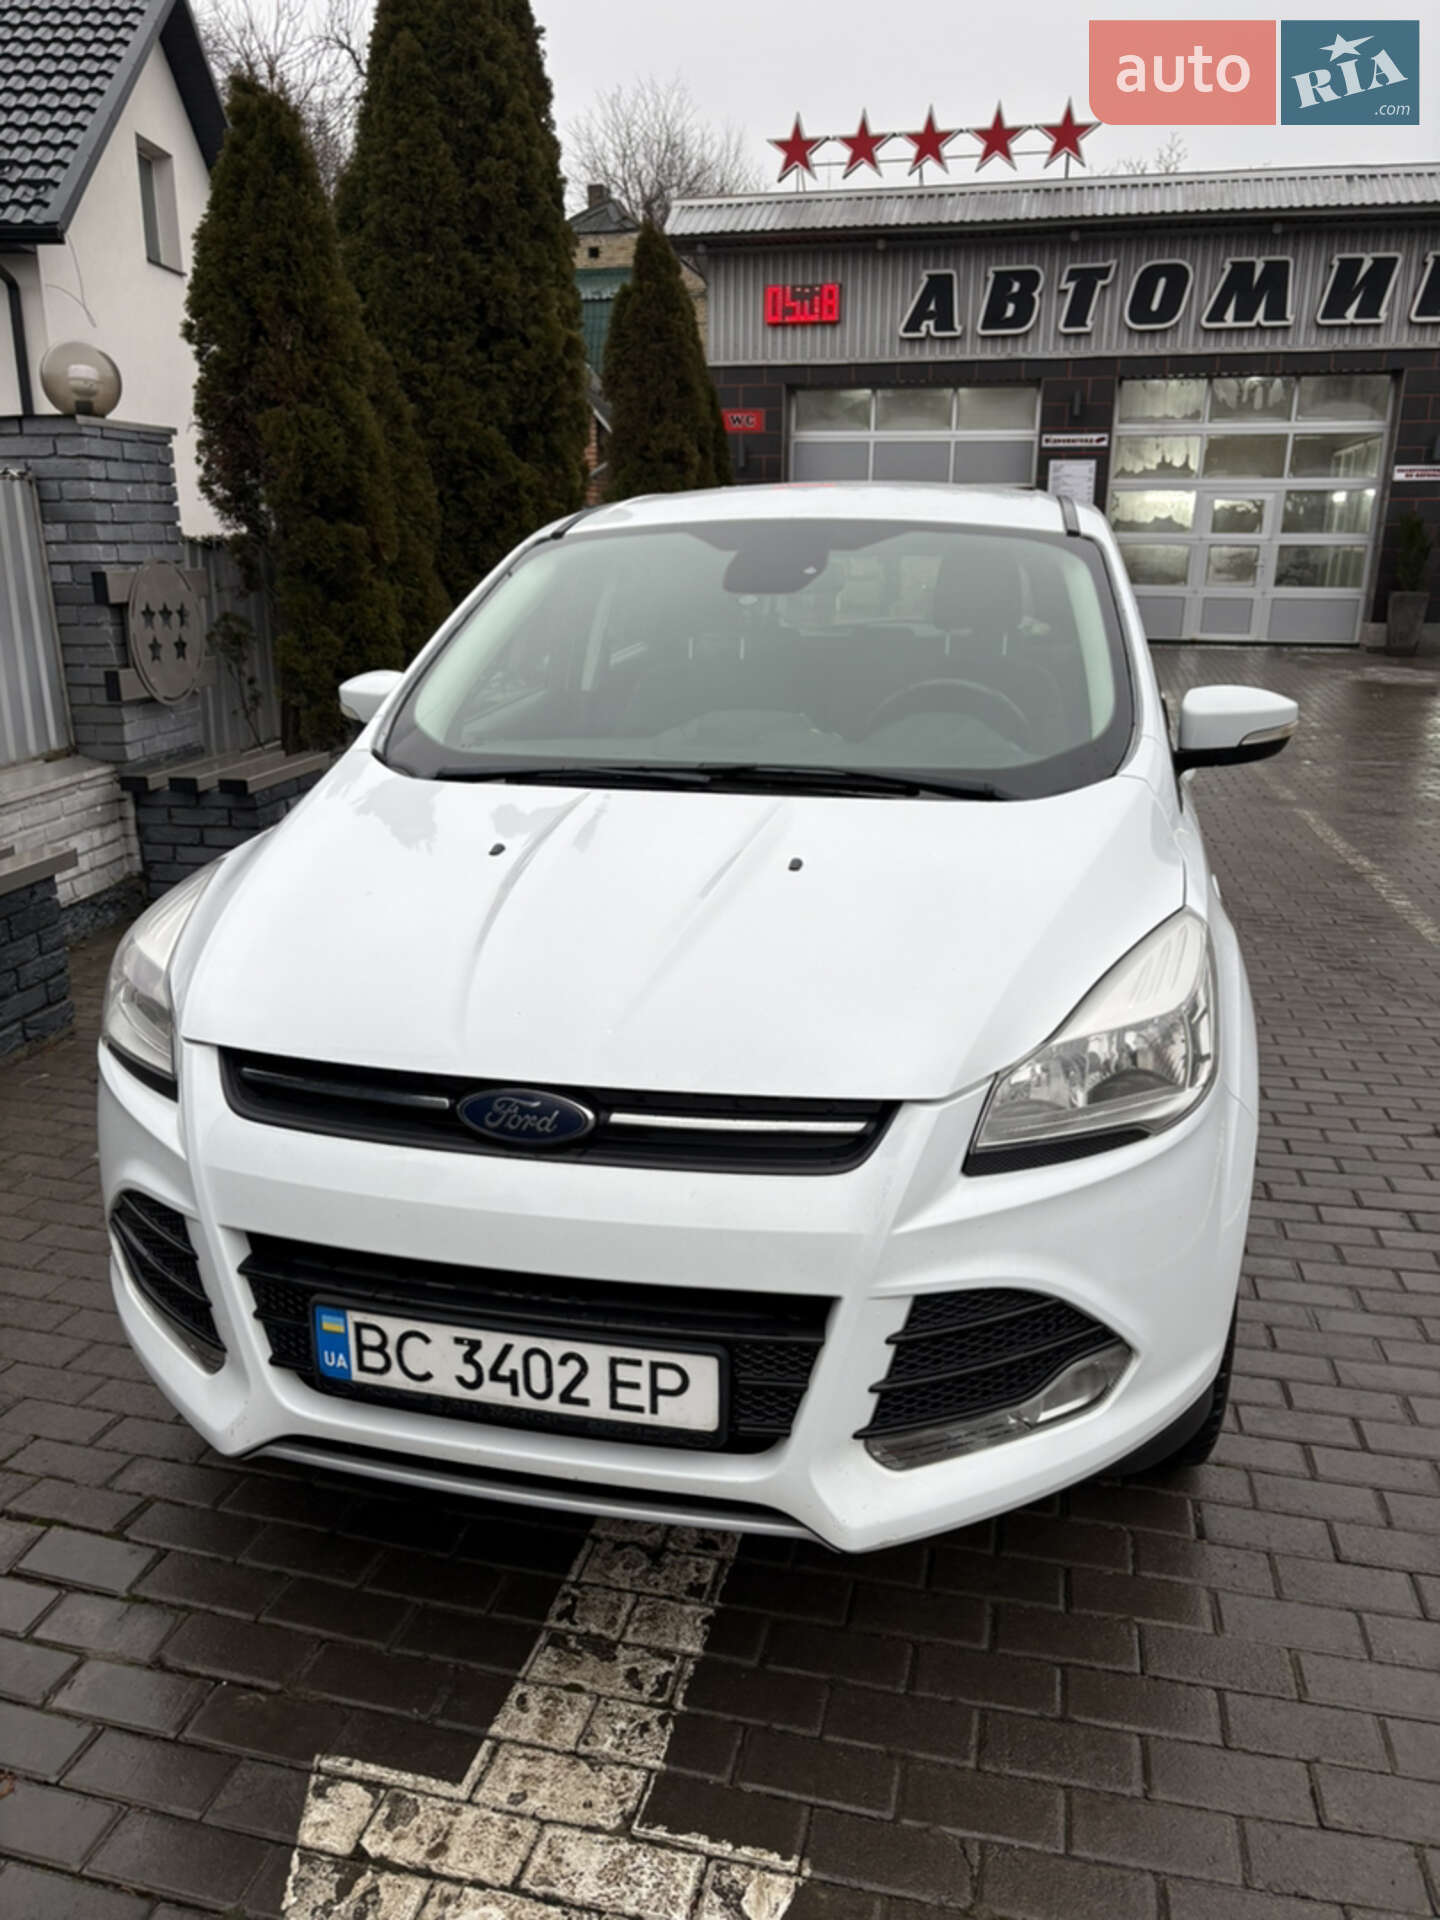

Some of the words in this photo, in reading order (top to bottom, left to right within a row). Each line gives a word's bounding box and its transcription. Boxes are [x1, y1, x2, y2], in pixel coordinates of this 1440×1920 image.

[729, 414, 756, 427] WC
[484, 1096, 561, 1133] Ford
[323, 1349, 349, 1371] UA
[353, 1321, 433, 1383] BC
[452, 1335, 591, 1408] 3402
[608, 1356, 690, 1415] EP
